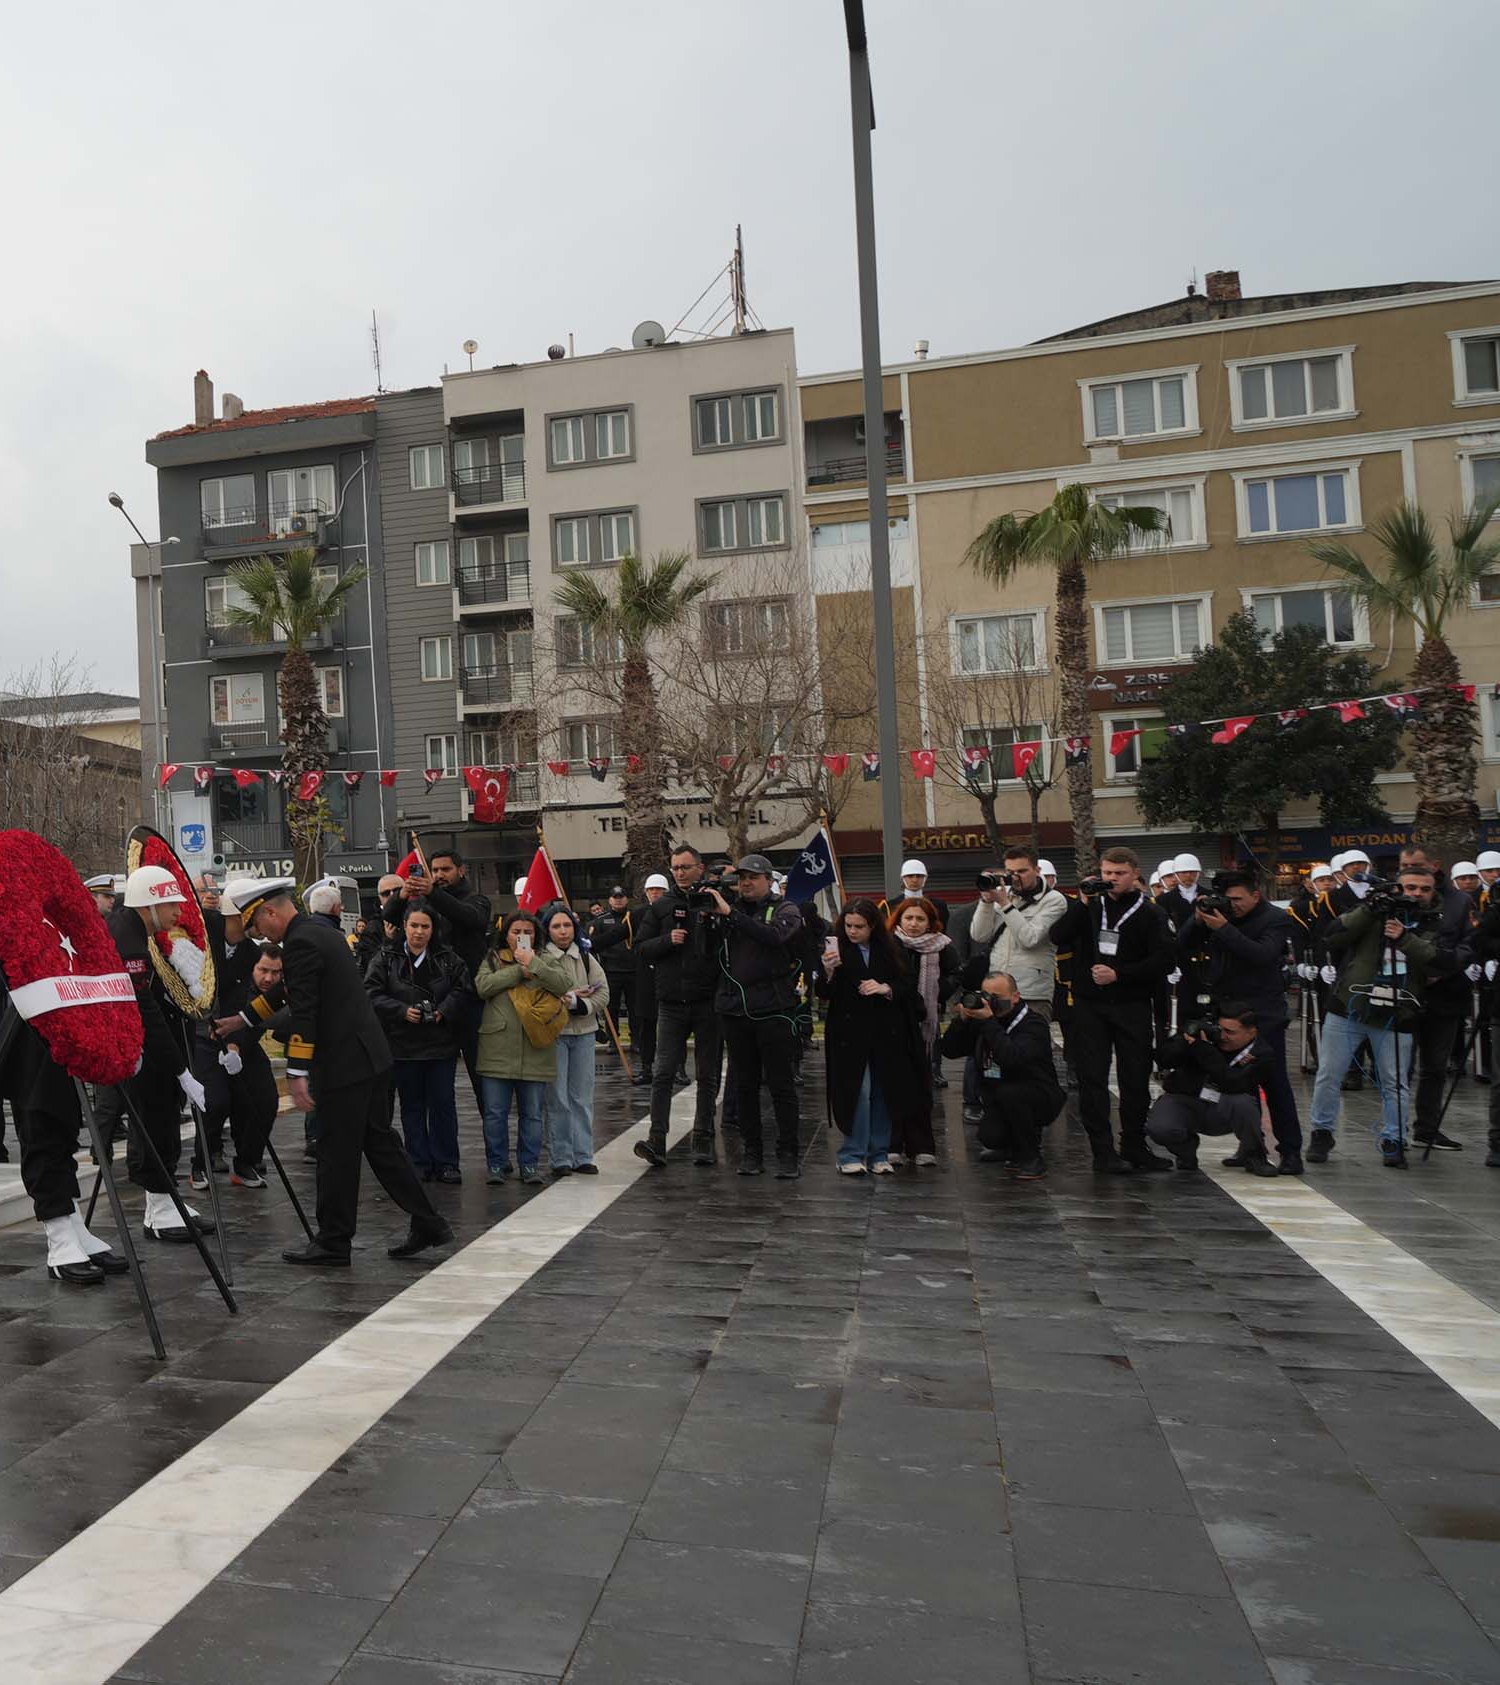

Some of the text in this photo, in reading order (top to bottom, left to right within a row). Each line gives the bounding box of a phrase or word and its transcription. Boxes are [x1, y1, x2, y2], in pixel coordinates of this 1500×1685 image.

[1124, 672, 1175, 686] ZERE
[1331, 832, 1407, 848] MEYDAN
[272, 860, 295, 877] 19
